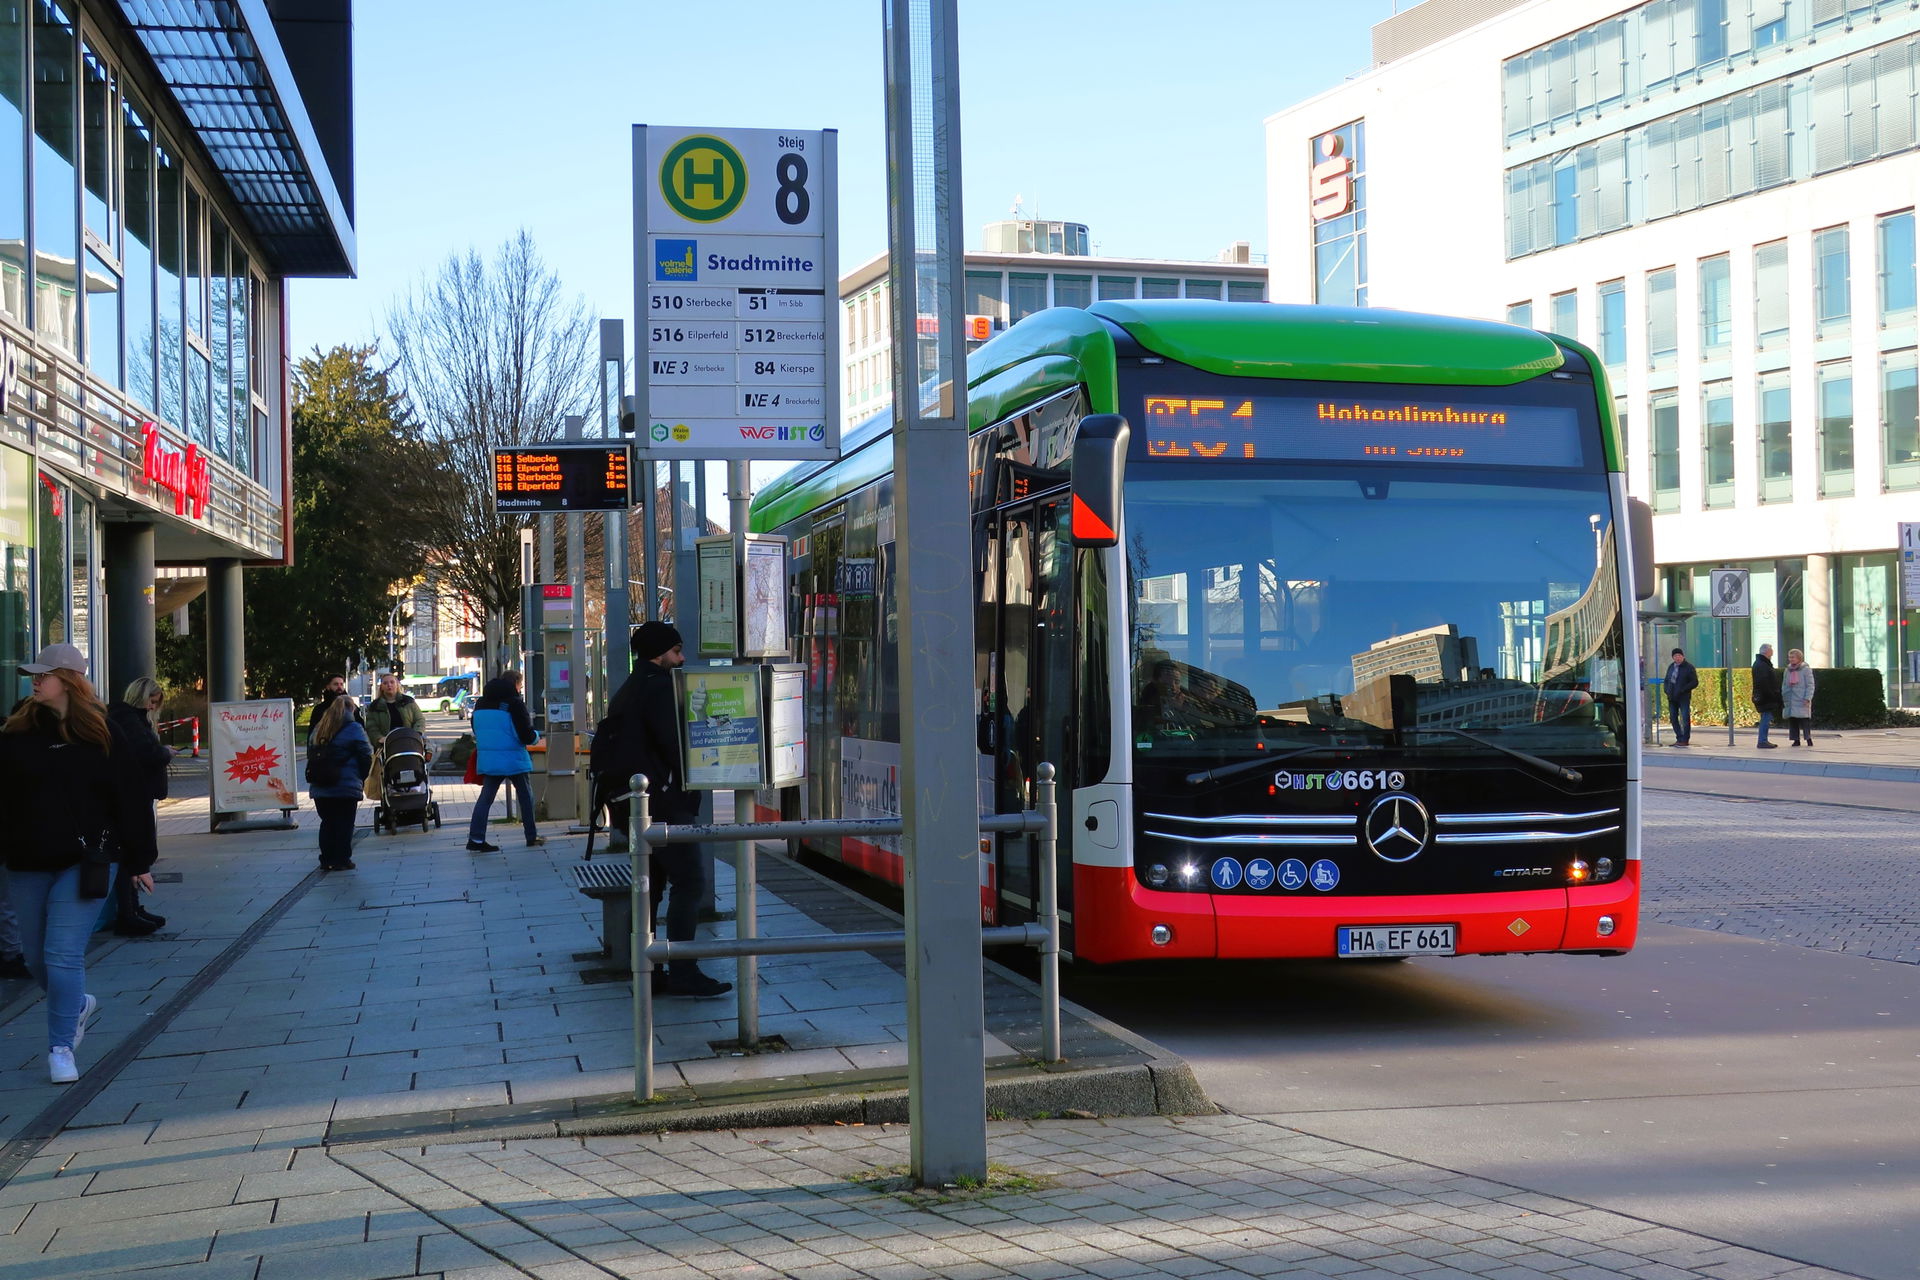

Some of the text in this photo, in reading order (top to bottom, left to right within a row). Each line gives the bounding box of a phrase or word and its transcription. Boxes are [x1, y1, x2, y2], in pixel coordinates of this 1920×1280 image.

[778, 136, 805, 151] Steig
[683, 158, 724, 200] H
[775, 153, 810, 225] 8
[708, 254, 814, 272] Stadtmitte
[664, 266, 693, 275] galerie
[651, 296, 732, 310] 510 Sterbecke
[749, 296, 767, 310] 51
[789, 300, 804, 308] Sibb
[652, 328, 728, 342] 516 Eilperfeld
[744, 328, 824, 342] 512 Breckerfeld
[680, 361, 688, 374] 3
[754, 362, 815, 376] 84 Kierspe
[772, 394, 780, 406] 4
[786, 397, 820, 405] Breckerfeld
[739, 426, 808, 440] MVG HST
[496, 455, 512, 464] 512
[516, 454, 557, 463] Selbecke
[608, 454, 614, 462] 2
[517, 464, 560, 472] Eilperfeld
[609, 462, 614, 470] 5
[497, 473, 512, 482] 510
[517, 472, 562, 482] Sterbecke
[498, 482, 512, 491] 516
[518, 482, 560, 491] Eilperfeld
[606, 481, 615, 489] 18
[1721, 606, 1740, 614] ZONE
[220, 708, 284, 722] Beauty Life
[242, 763, 266, 774] 25€
[842, 759, 879, 811] Fliesen
[1293, 774, 1324, 790] HST
[1343, 770, 1387, 790] 661
[1494, 868, 1552, 876] eCITARO
[1350, 931, 1374, 950] HA
[1388, 930, 1412, 950] EF
[1417, 930, 1451, 949] 661
